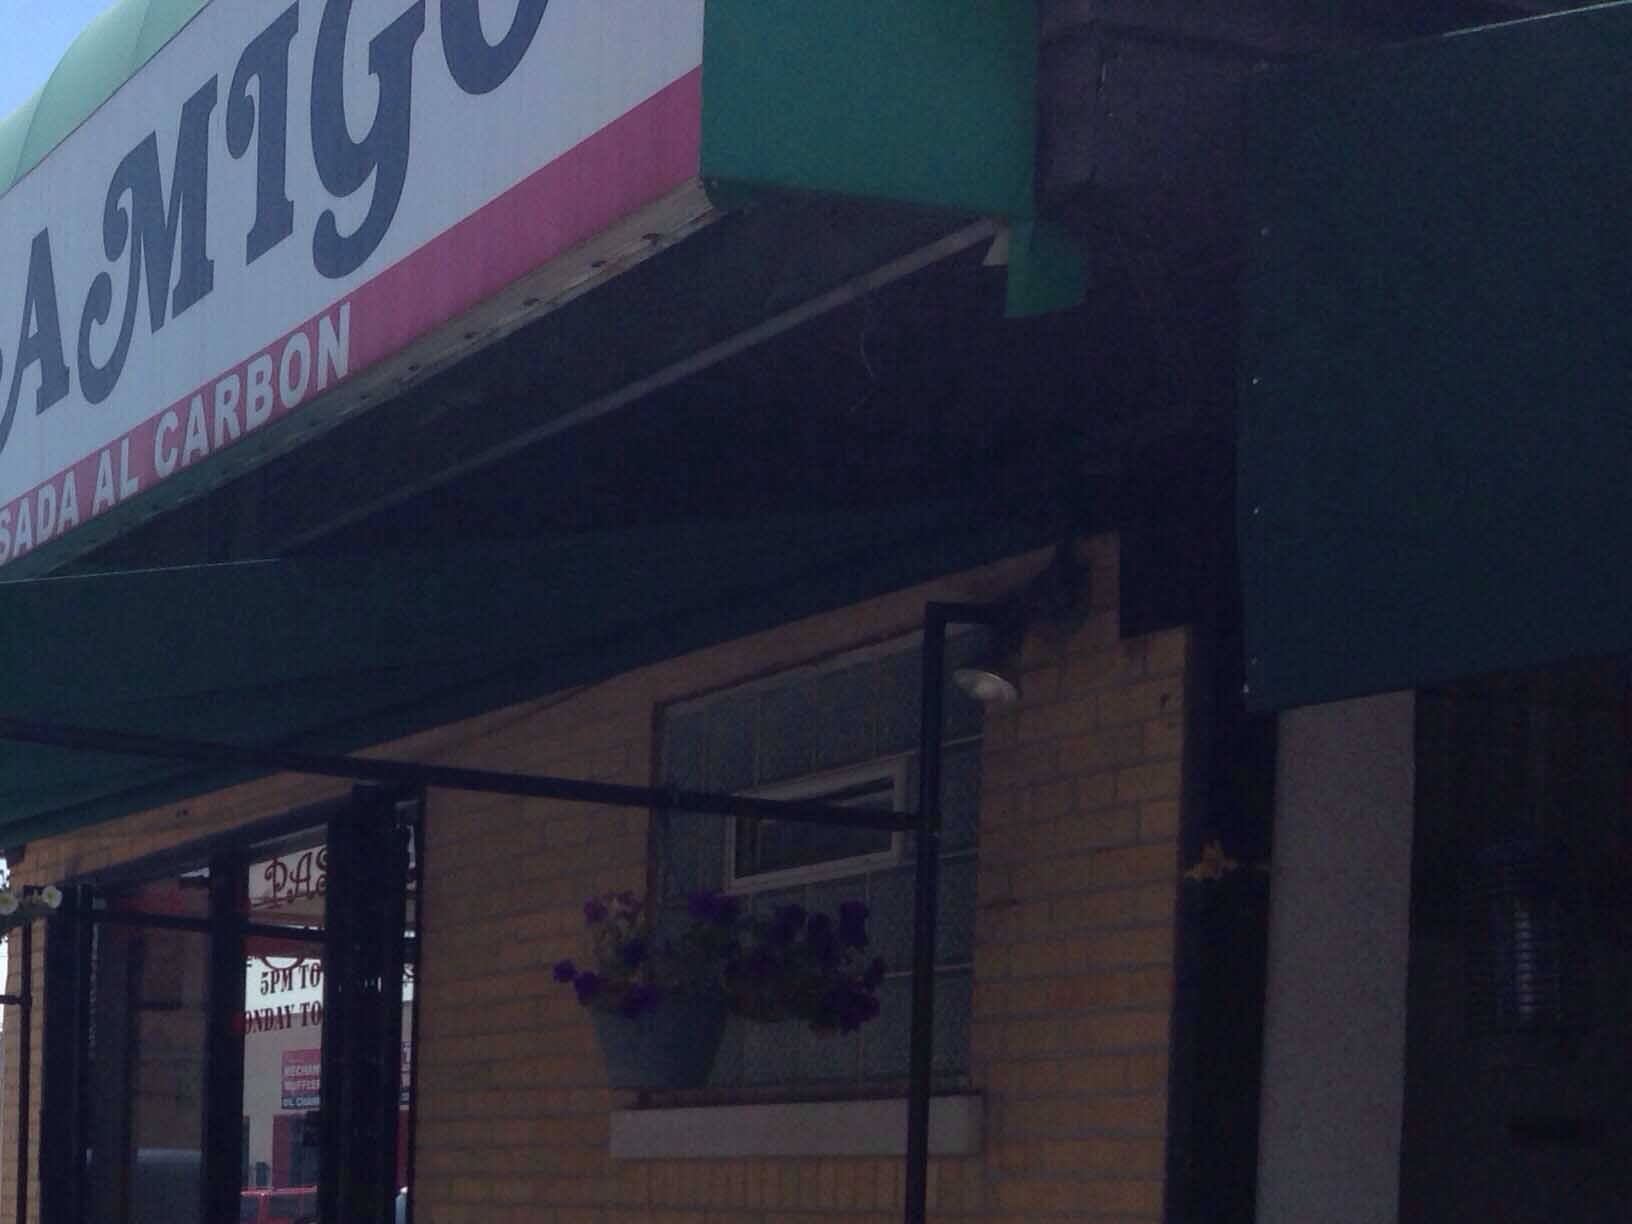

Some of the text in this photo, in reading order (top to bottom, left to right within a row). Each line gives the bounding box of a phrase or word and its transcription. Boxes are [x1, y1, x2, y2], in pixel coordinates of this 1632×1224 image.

[92, 436, 141, 517] AL
[153, 301, 352, 479] CARBON
[260, 968, 293, 996] 5PM
[240, 1003, 295, 1034] ONDAY
